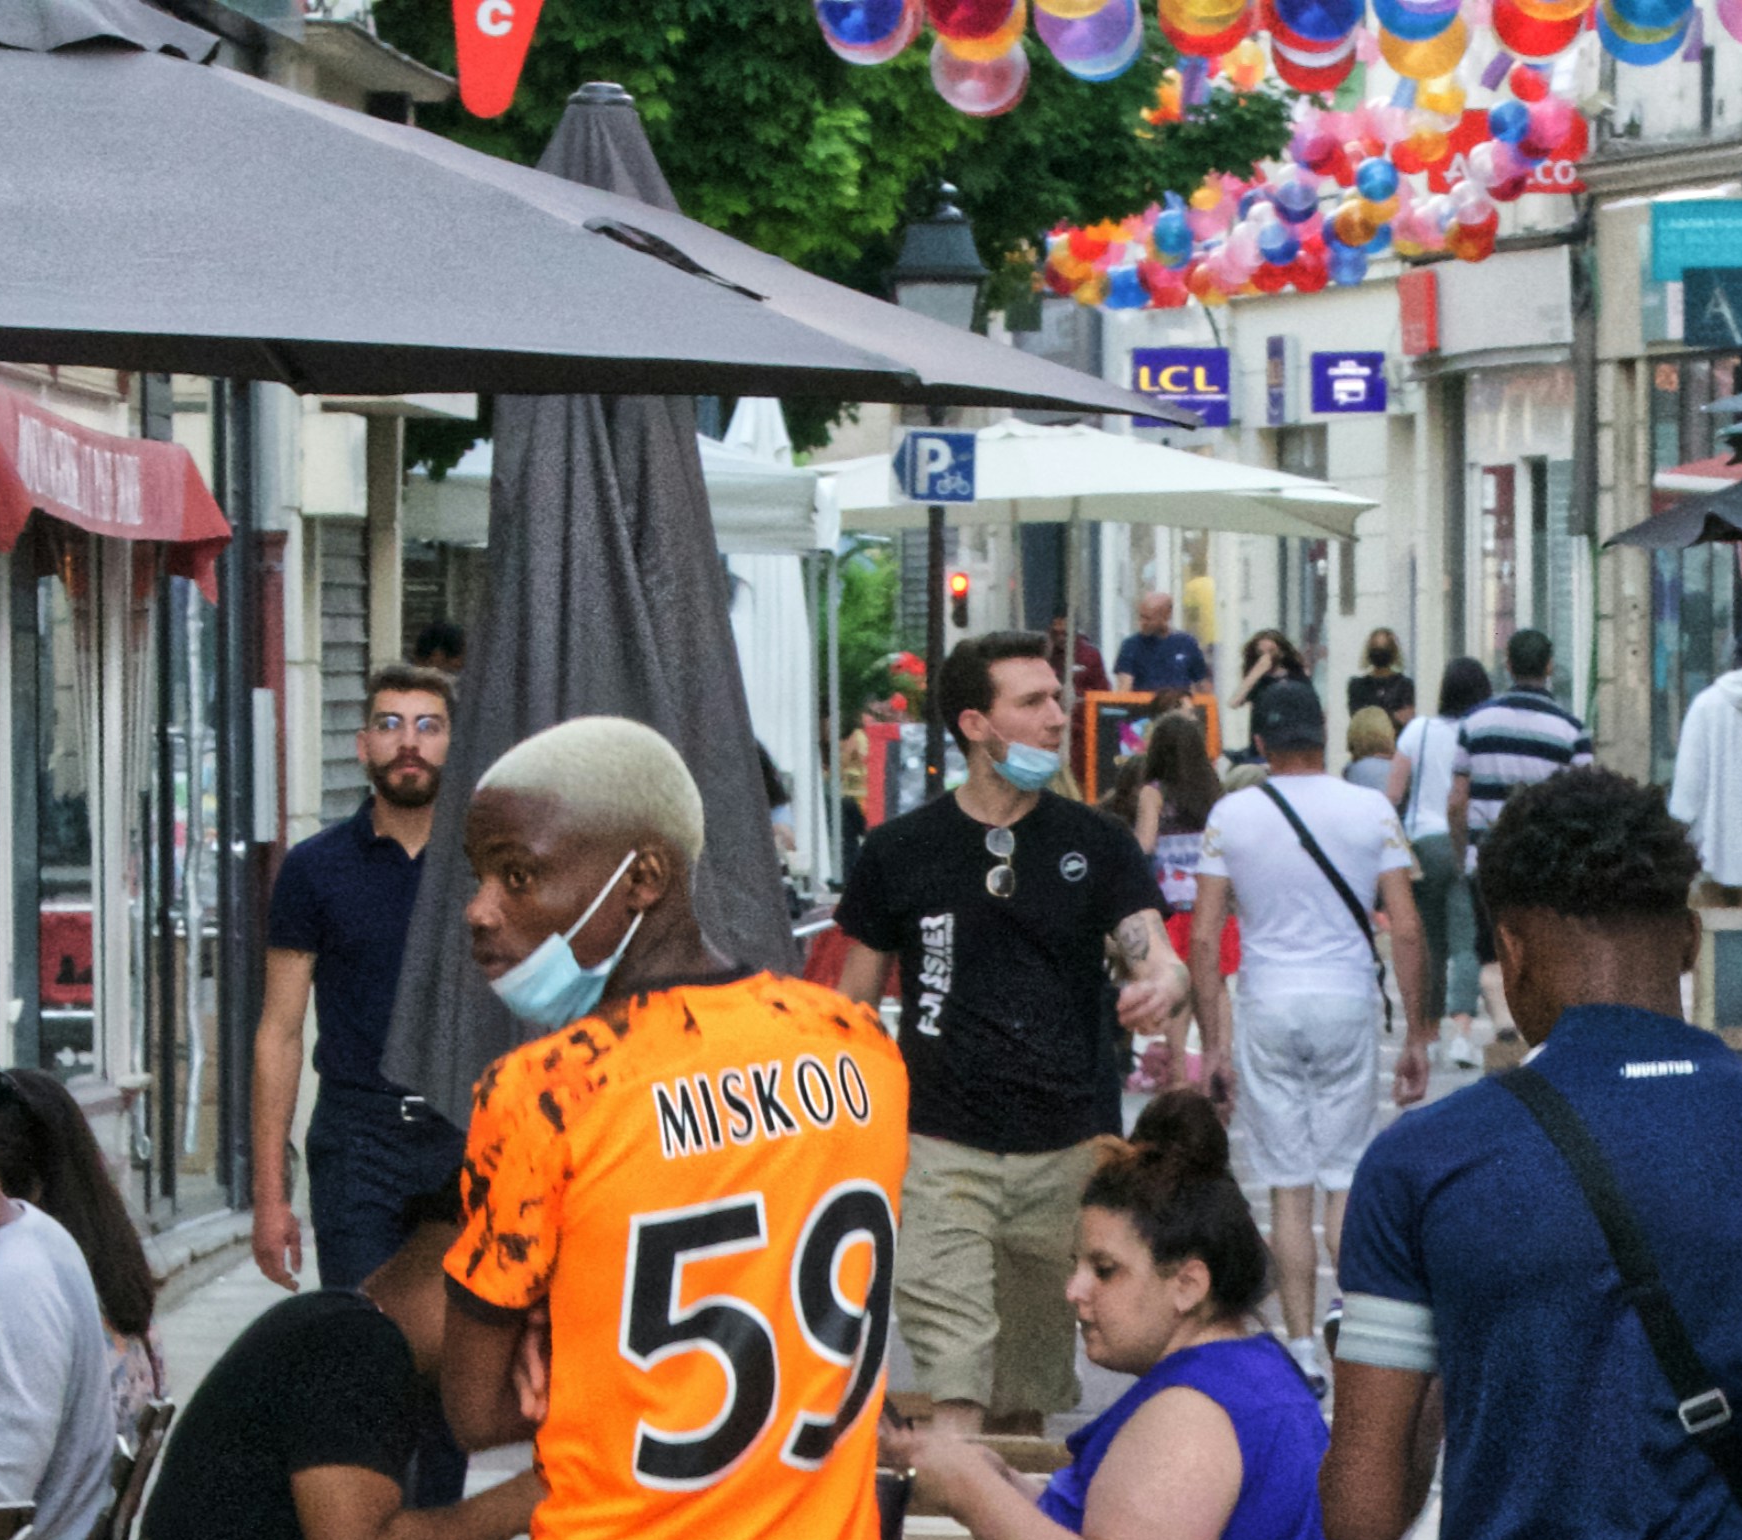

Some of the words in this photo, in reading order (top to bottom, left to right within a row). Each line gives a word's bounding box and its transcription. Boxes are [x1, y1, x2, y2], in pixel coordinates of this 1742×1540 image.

[475, 0, 514, 36] C
[1139, 365, 1220, 392] LCL
[916, 438, 952, 494] P
[652, 1050, 871, 1160] MISKOO
[618, 1177, 898, 1493] 59
